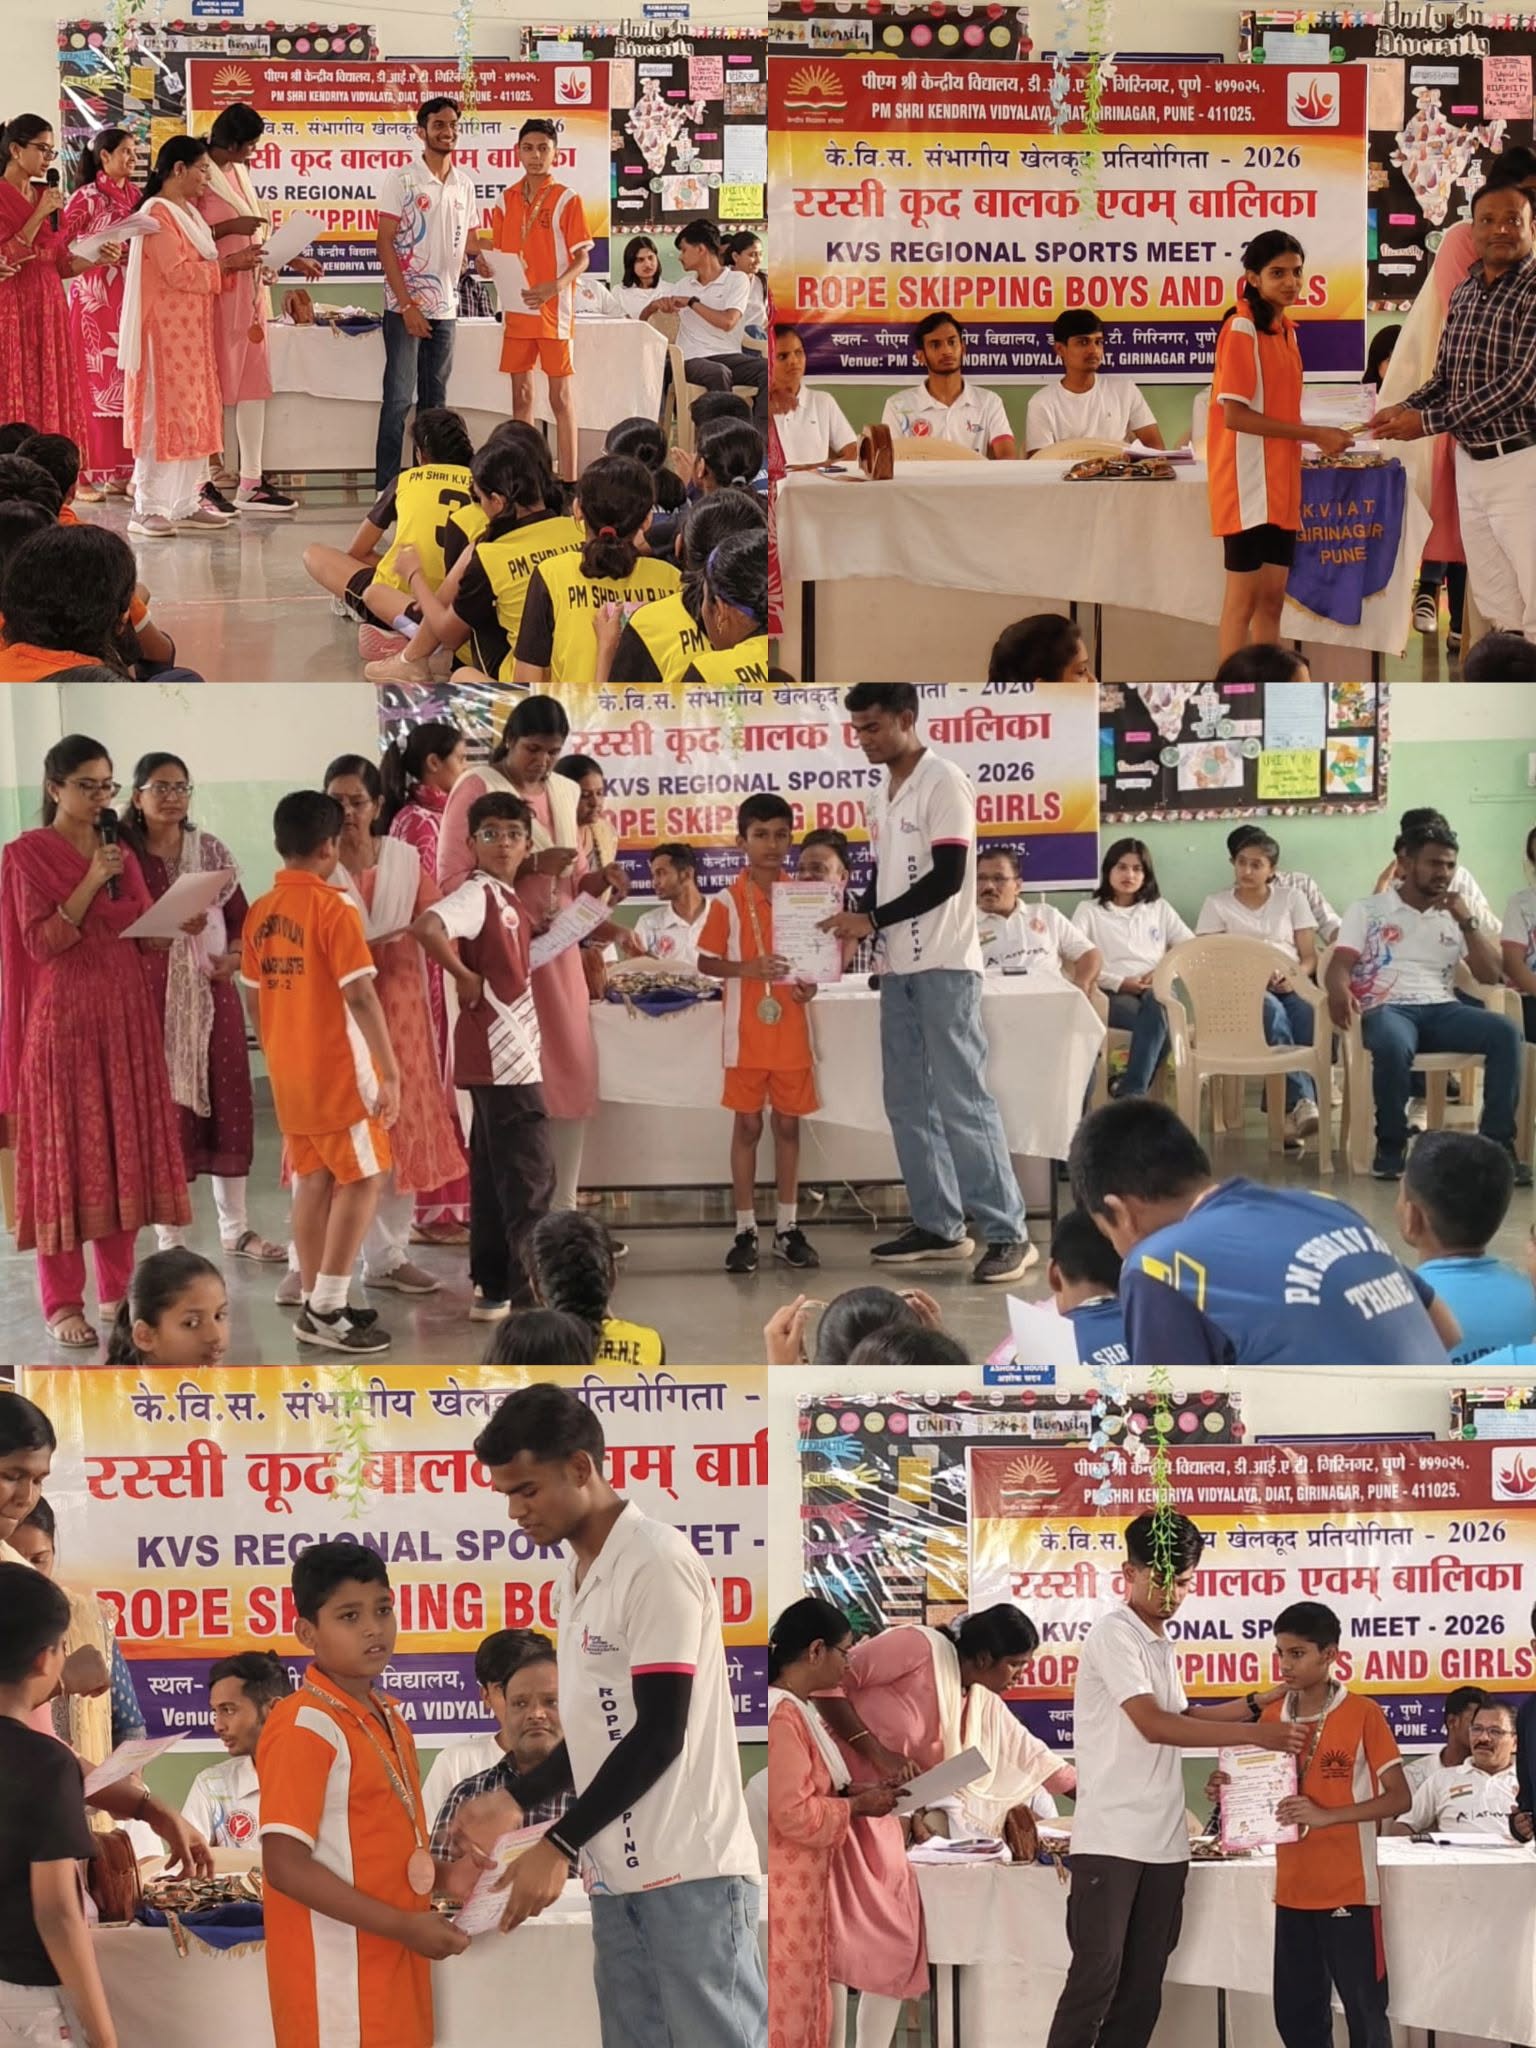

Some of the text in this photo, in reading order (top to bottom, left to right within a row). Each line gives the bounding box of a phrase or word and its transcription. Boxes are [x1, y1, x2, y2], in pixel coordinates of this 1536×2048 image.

[264, 68, 288, 83] पीएम
[290, 68, 302, 83] श्री
[861, 70, 896, 91] पीएम
[901, 70, 917, 91] श्री
[921, 70, 964, 92] केन्द्रीय
[968, 72, 1023, 93] विद्यालय,
[1179, 75, 1200, 98] पुणे
[271, 91, 285, 102] PM
[286, 91, 307, 102] SHRI
[309, 91, 349, 102] KENDRIYA
[872, 103, 891, 118] PM
[895, 103, 924, 119] SHRI
[928, 103, 986, 120] KENDRIYA
[1164, 105, 1195, 121] PUNE
[1207, 105, 1256, 122] 411025.
[824, 139, 912, 168] के.वि.स.
[924, 141, 1010, 168] संभागीय
[1102, 143, 1209, 169] प्रतियोगिता
[1243, 146, 1301, 169] 2026
[255, 184, 507, 201] VS REGIONAL EET
[792, 178, 1318, 229] रस्सी कूद बालक एवम् बालिका
[827, 241, 881, 263] KVS
[890, 241, 1027, 263] REGIONAL
[1035, 241, 1138, 263] SPORTS
[1147, 241, 1217, 263] MEET
[323, 261, 366, 272] KENDRIYA
[797, 276, 888, 309] ROPE
[899, 276, 1054, 309] SKIPPING
[1065, 275, 1149, 308] BOYS
[1159, 275, 1225, 308] AND
[874, 329, 909, 349] पीएम
[1195, 328, 1217, 348] पुणे
[840, 353, 884, 368] Venue:
[887, 353, 908, 368] PM
[962, 353, 1008, 367] NDRIYA
[1119, 352, 1185, 366] GIRINAGAR
[1189, 352, 1216, 366] PUN
[409, 471, 424, 484] PM
[508, 555, 531, 580] PM
[1320, 546, 1367, 565] PUNE
[568, 585, 589, 609] PM
[679, 628, 705, 655] PM
[571, 720, 654, 757] रस्सी
[928, 706, 1052, 744] बालिका
[603, 762, 1035, 798] KVS REGIONAL SPORTS 2026
[976, 792, 1061, 823] GIRLS
[1284, 1263, 1323, 1307] PM
[1343, 1271, 1415, 1320] THANE
[1092, 1343, 1130, 1365] SHR
[131, 1382, 266, 1423] के.वि.स.
[83, 1438, 228, 1500] रस्सी
[245, 1452, 343, 1515] कूद
[1382, 1453, 1406, 1477] पुणे
[1368, 1483, 1399, 1498] PUNE
[1411, 1482, 1461, 1498] 411025.
[137, 1535, 220, 1569] KVS
[456, 1528, 566, 1563] SPOR
[1226, 1523, 1299, 1556] खेलकूद
[1306, 1519, 1413, 1548] प्रतियोगिता
[1448, 1520, 1507, 1543] 2026
[1010, 1561, 1099, 1600] रस्सी
[1298, 1566, 1382, 1602] एवम्
[1392, 1554, 1524, 1594] बालिका
[96, 1588, 229, 1637] ROPE
[1350, 1615, 1421, 1639] MEET
[1444, 1614, 1506, 1636] 2026
[1364, 1649, 1429, 1681] AND
[1441, 1647, 1533, 1679] GIRLS
[162, 1707, 217, 1727] Venue
[598, 1687, 622, 1741] ROPE
[1394, 1724, 1427, 1738] PUNE
